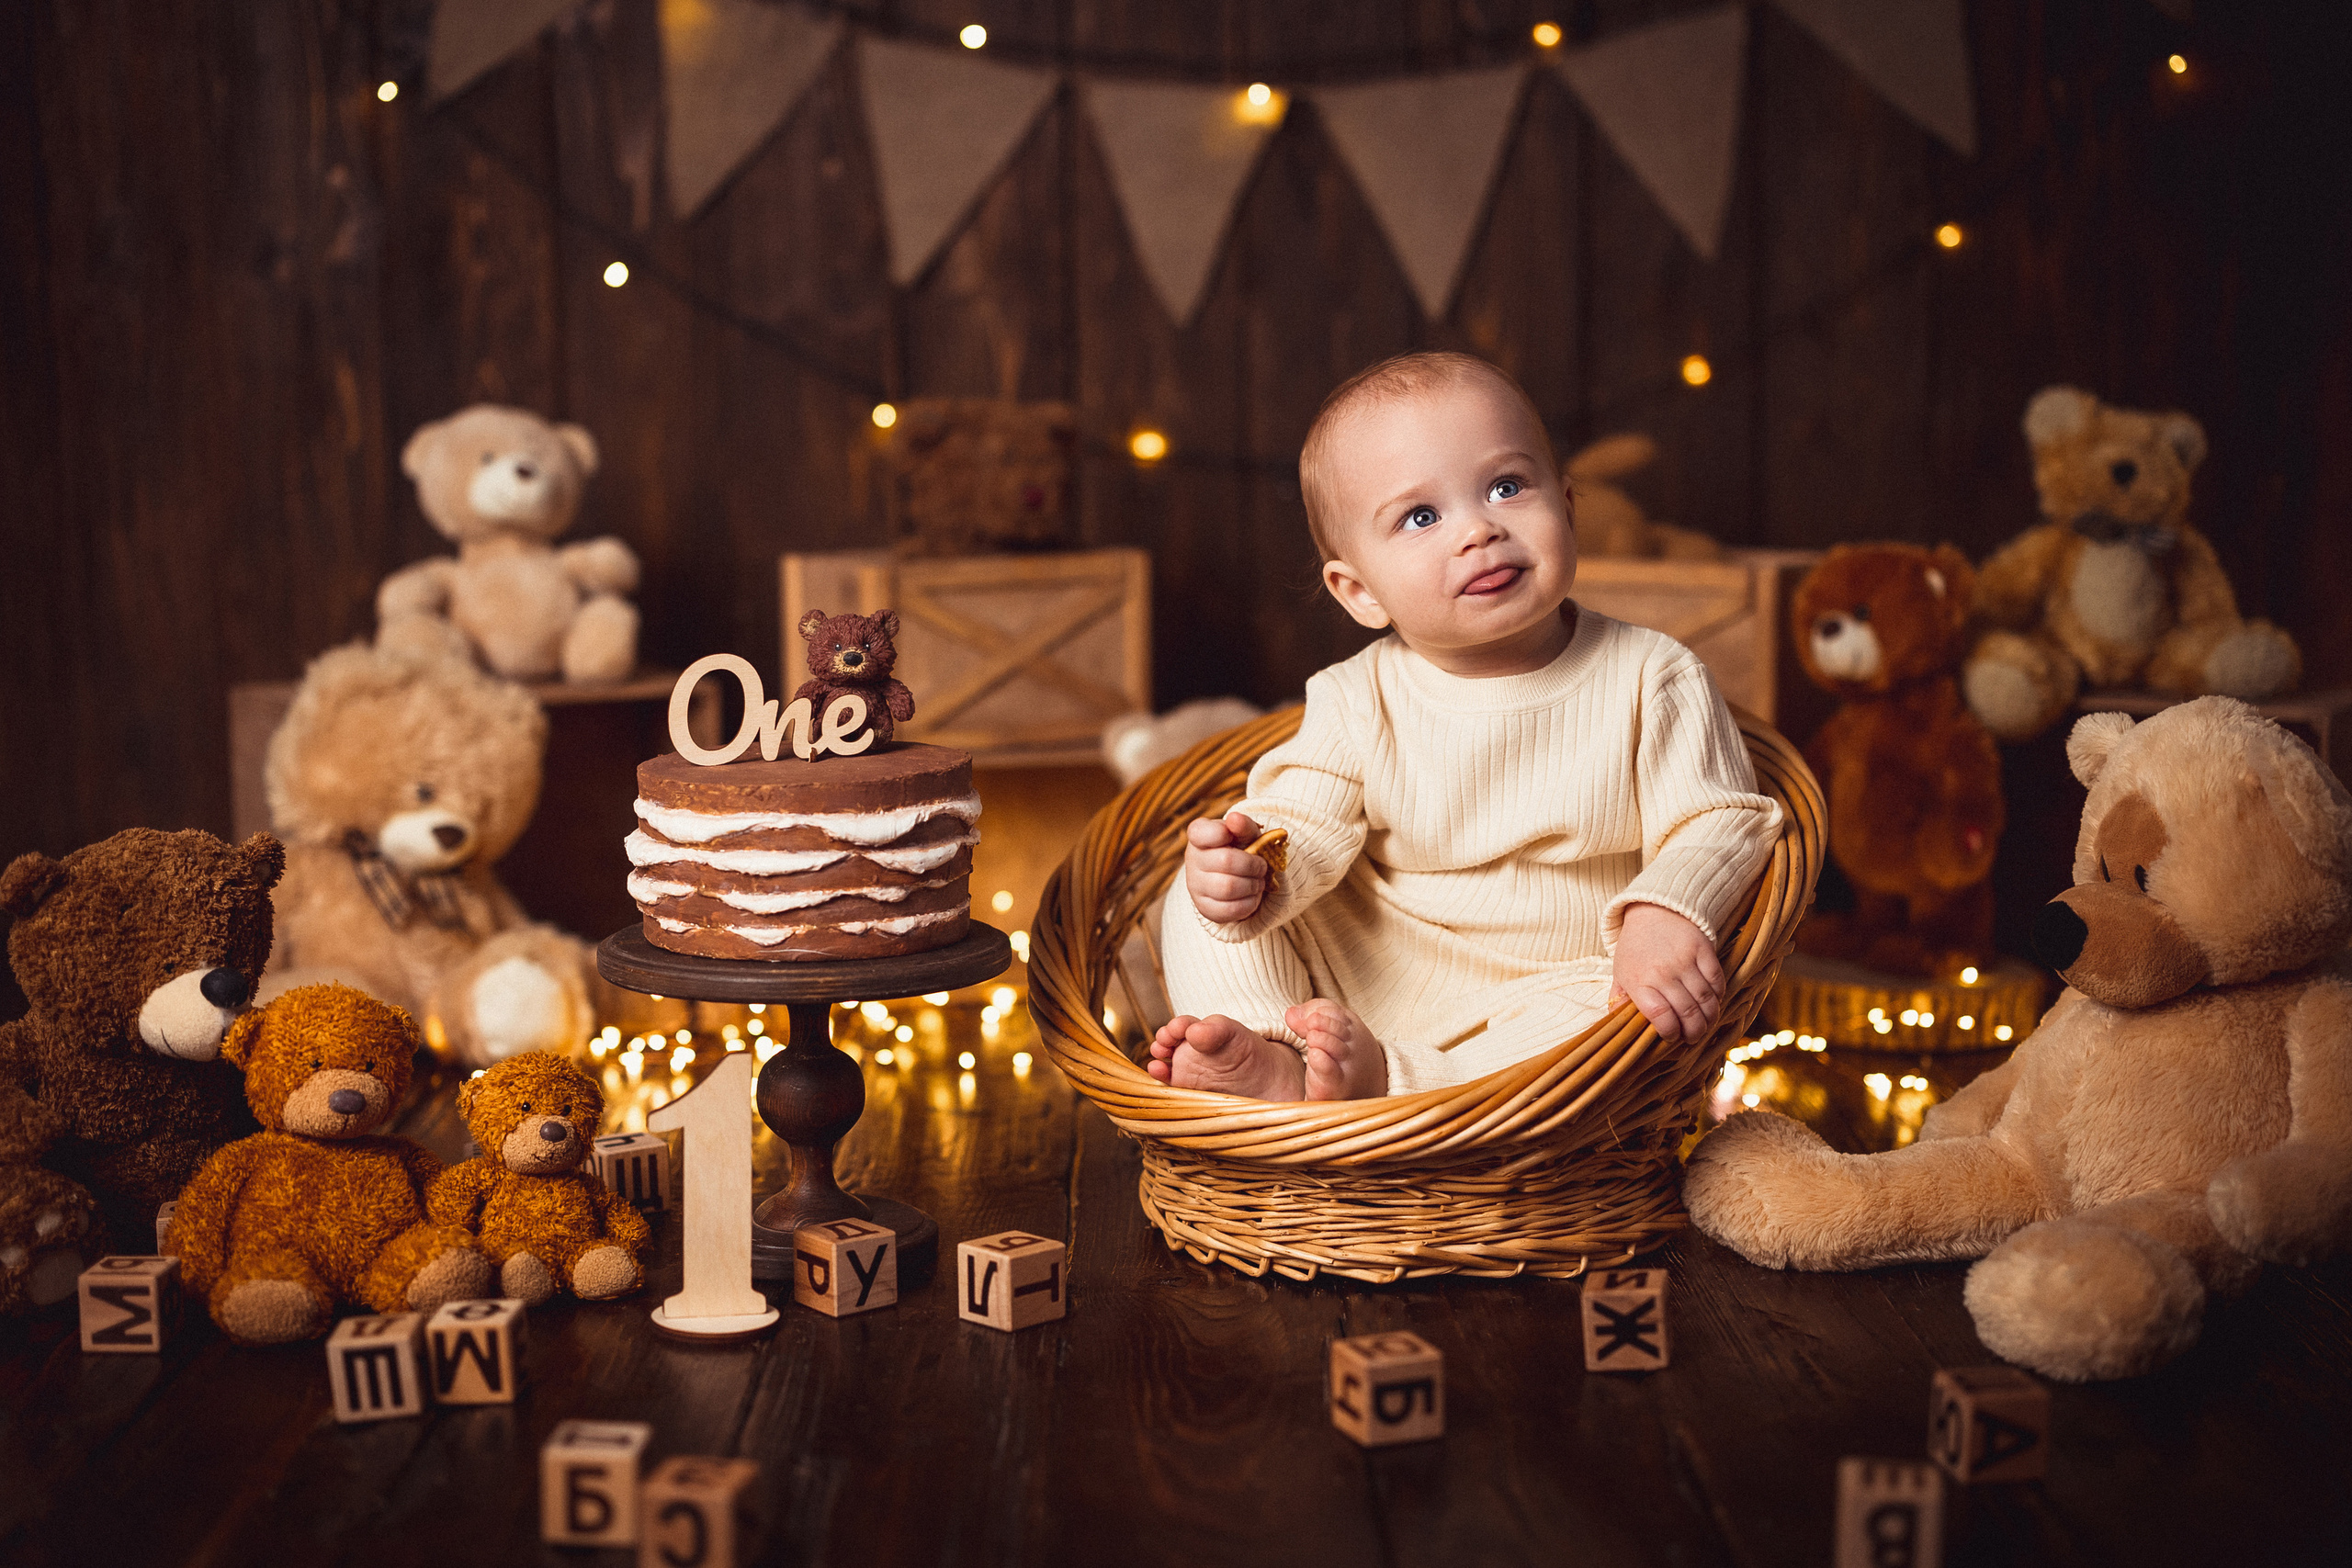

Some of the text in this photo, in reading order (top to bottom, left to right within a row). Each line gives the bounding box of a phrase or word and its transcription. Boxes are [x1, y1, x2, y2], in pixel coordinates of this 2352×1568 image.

[668, 653, 875, 766] One
[647, 1052, 768, 1320] 1
[822, 1222, 880, 1240] Д
[797, 1249, 830, 1295] Р
[846, 1244, 888, 1307] У
[1013, 1263, 1060, 1303] Т
[89, 1285, 154, 1346] М
[1593, 1297, 1660, 1360] Ж
[434, 1330, 502, 1393] М
[1375, 1380, 1433, 1425] Б
[1973, 1410, 2039, 1472] А
[566, 1463, 612, 1534] Б
